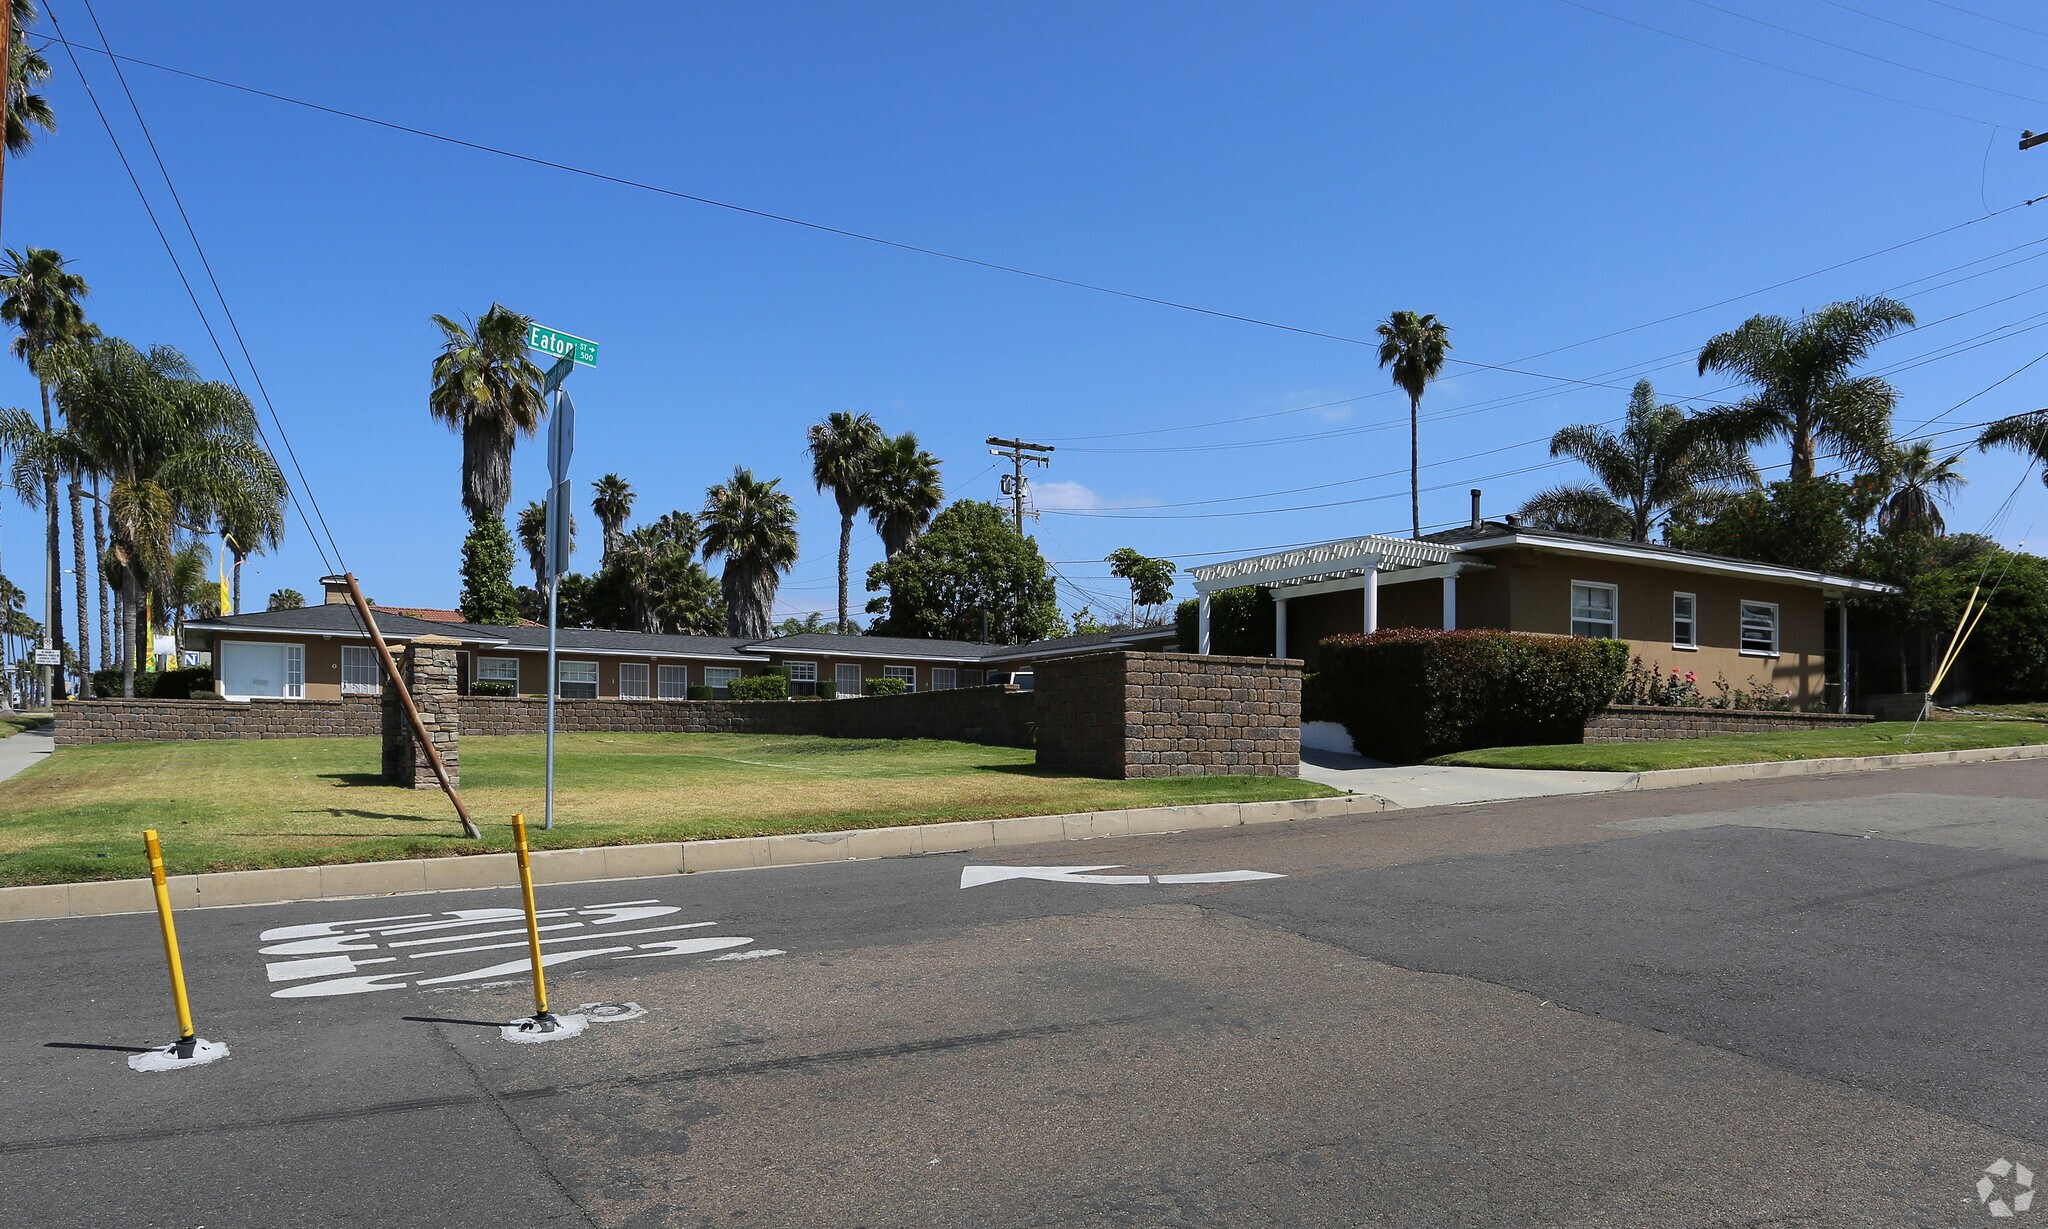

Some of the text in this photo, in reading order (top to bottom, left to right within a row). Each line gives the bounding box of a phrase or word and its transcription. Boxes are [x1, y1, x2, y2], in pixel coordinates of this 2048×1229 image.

[531, 327, 573, 354] Eaton
[581, 352, 593, 361] 500
[258, 898, 755, 999] STOP
